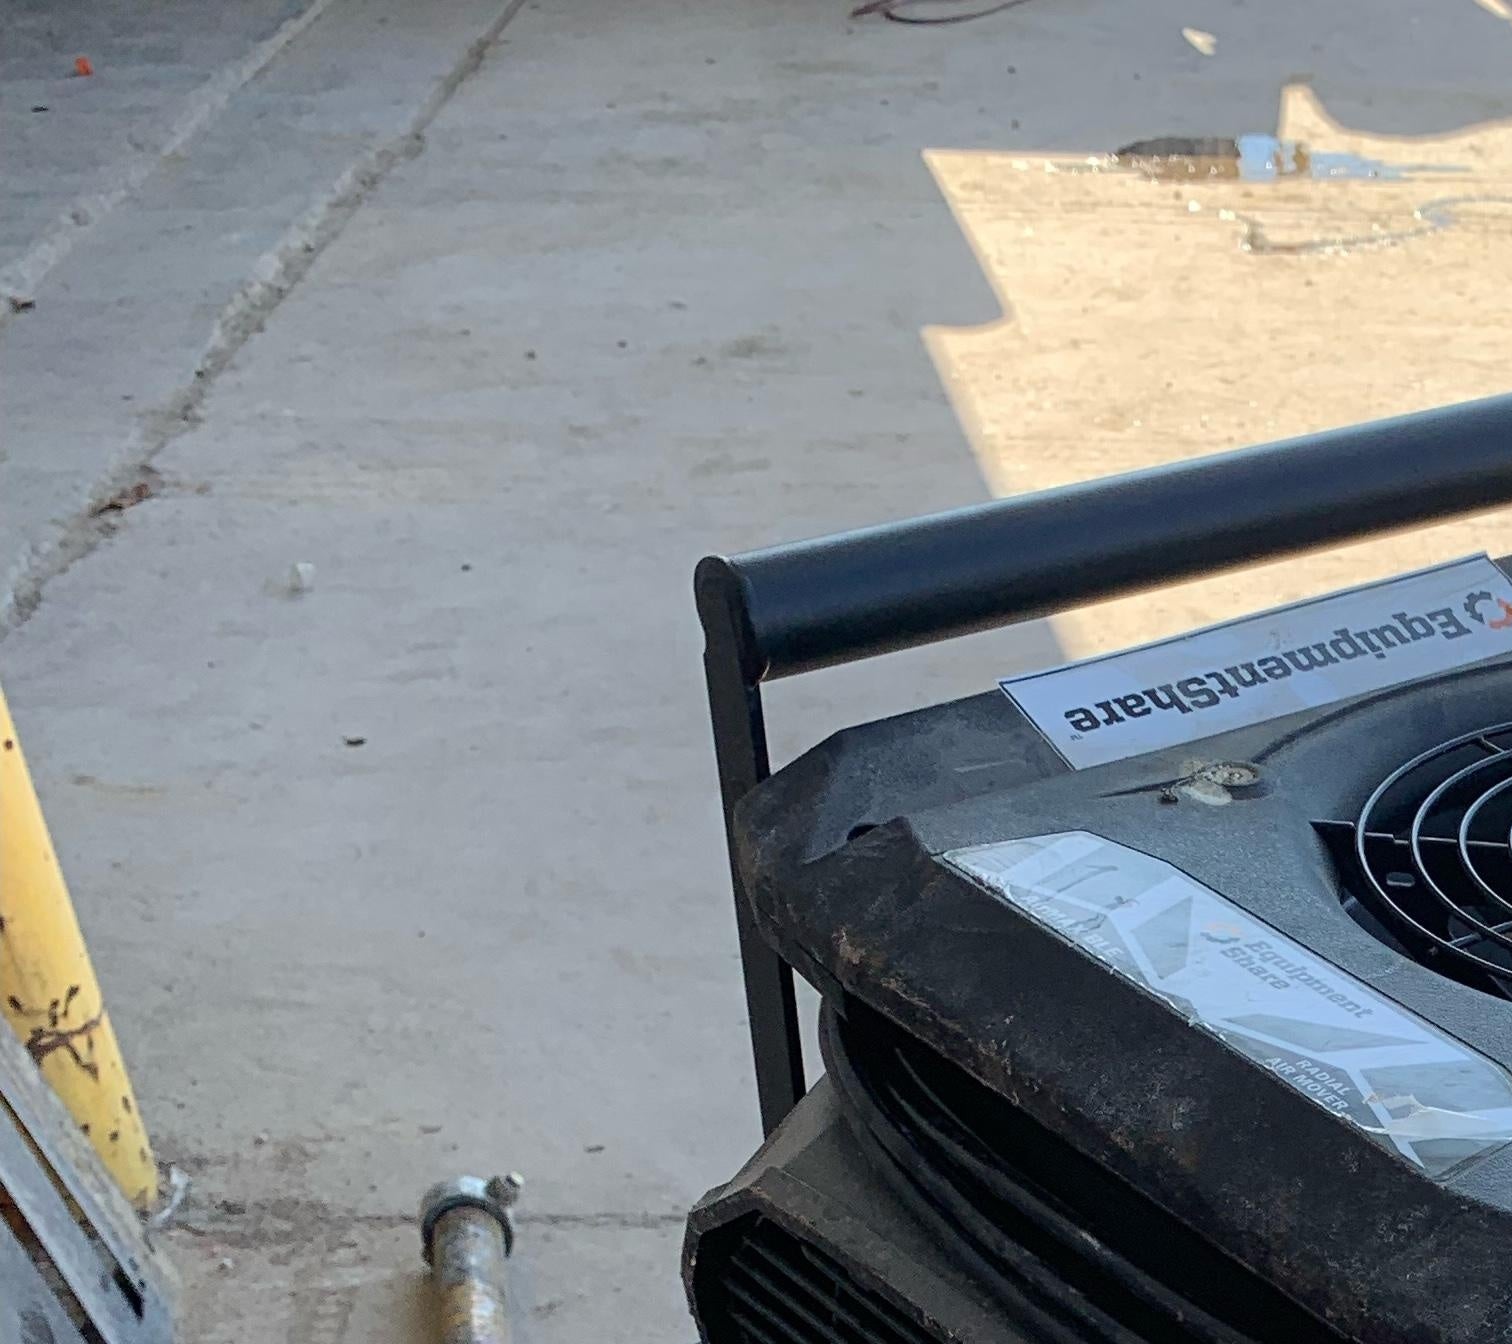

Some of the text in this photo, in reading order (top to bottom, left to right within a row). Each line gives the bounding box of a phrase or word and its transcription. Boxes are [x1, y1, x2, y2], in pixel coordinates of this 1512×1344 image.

[1064, 607, 1473, 732] EquipmentShare
[1220, 947, 1291, 990] Share
[1246, 940, 1374, 1019] Equipment
[1265, 1057, 1349, 1111] AIR MOVER
[1295, 1058, 1351, 1096] RADIAL
